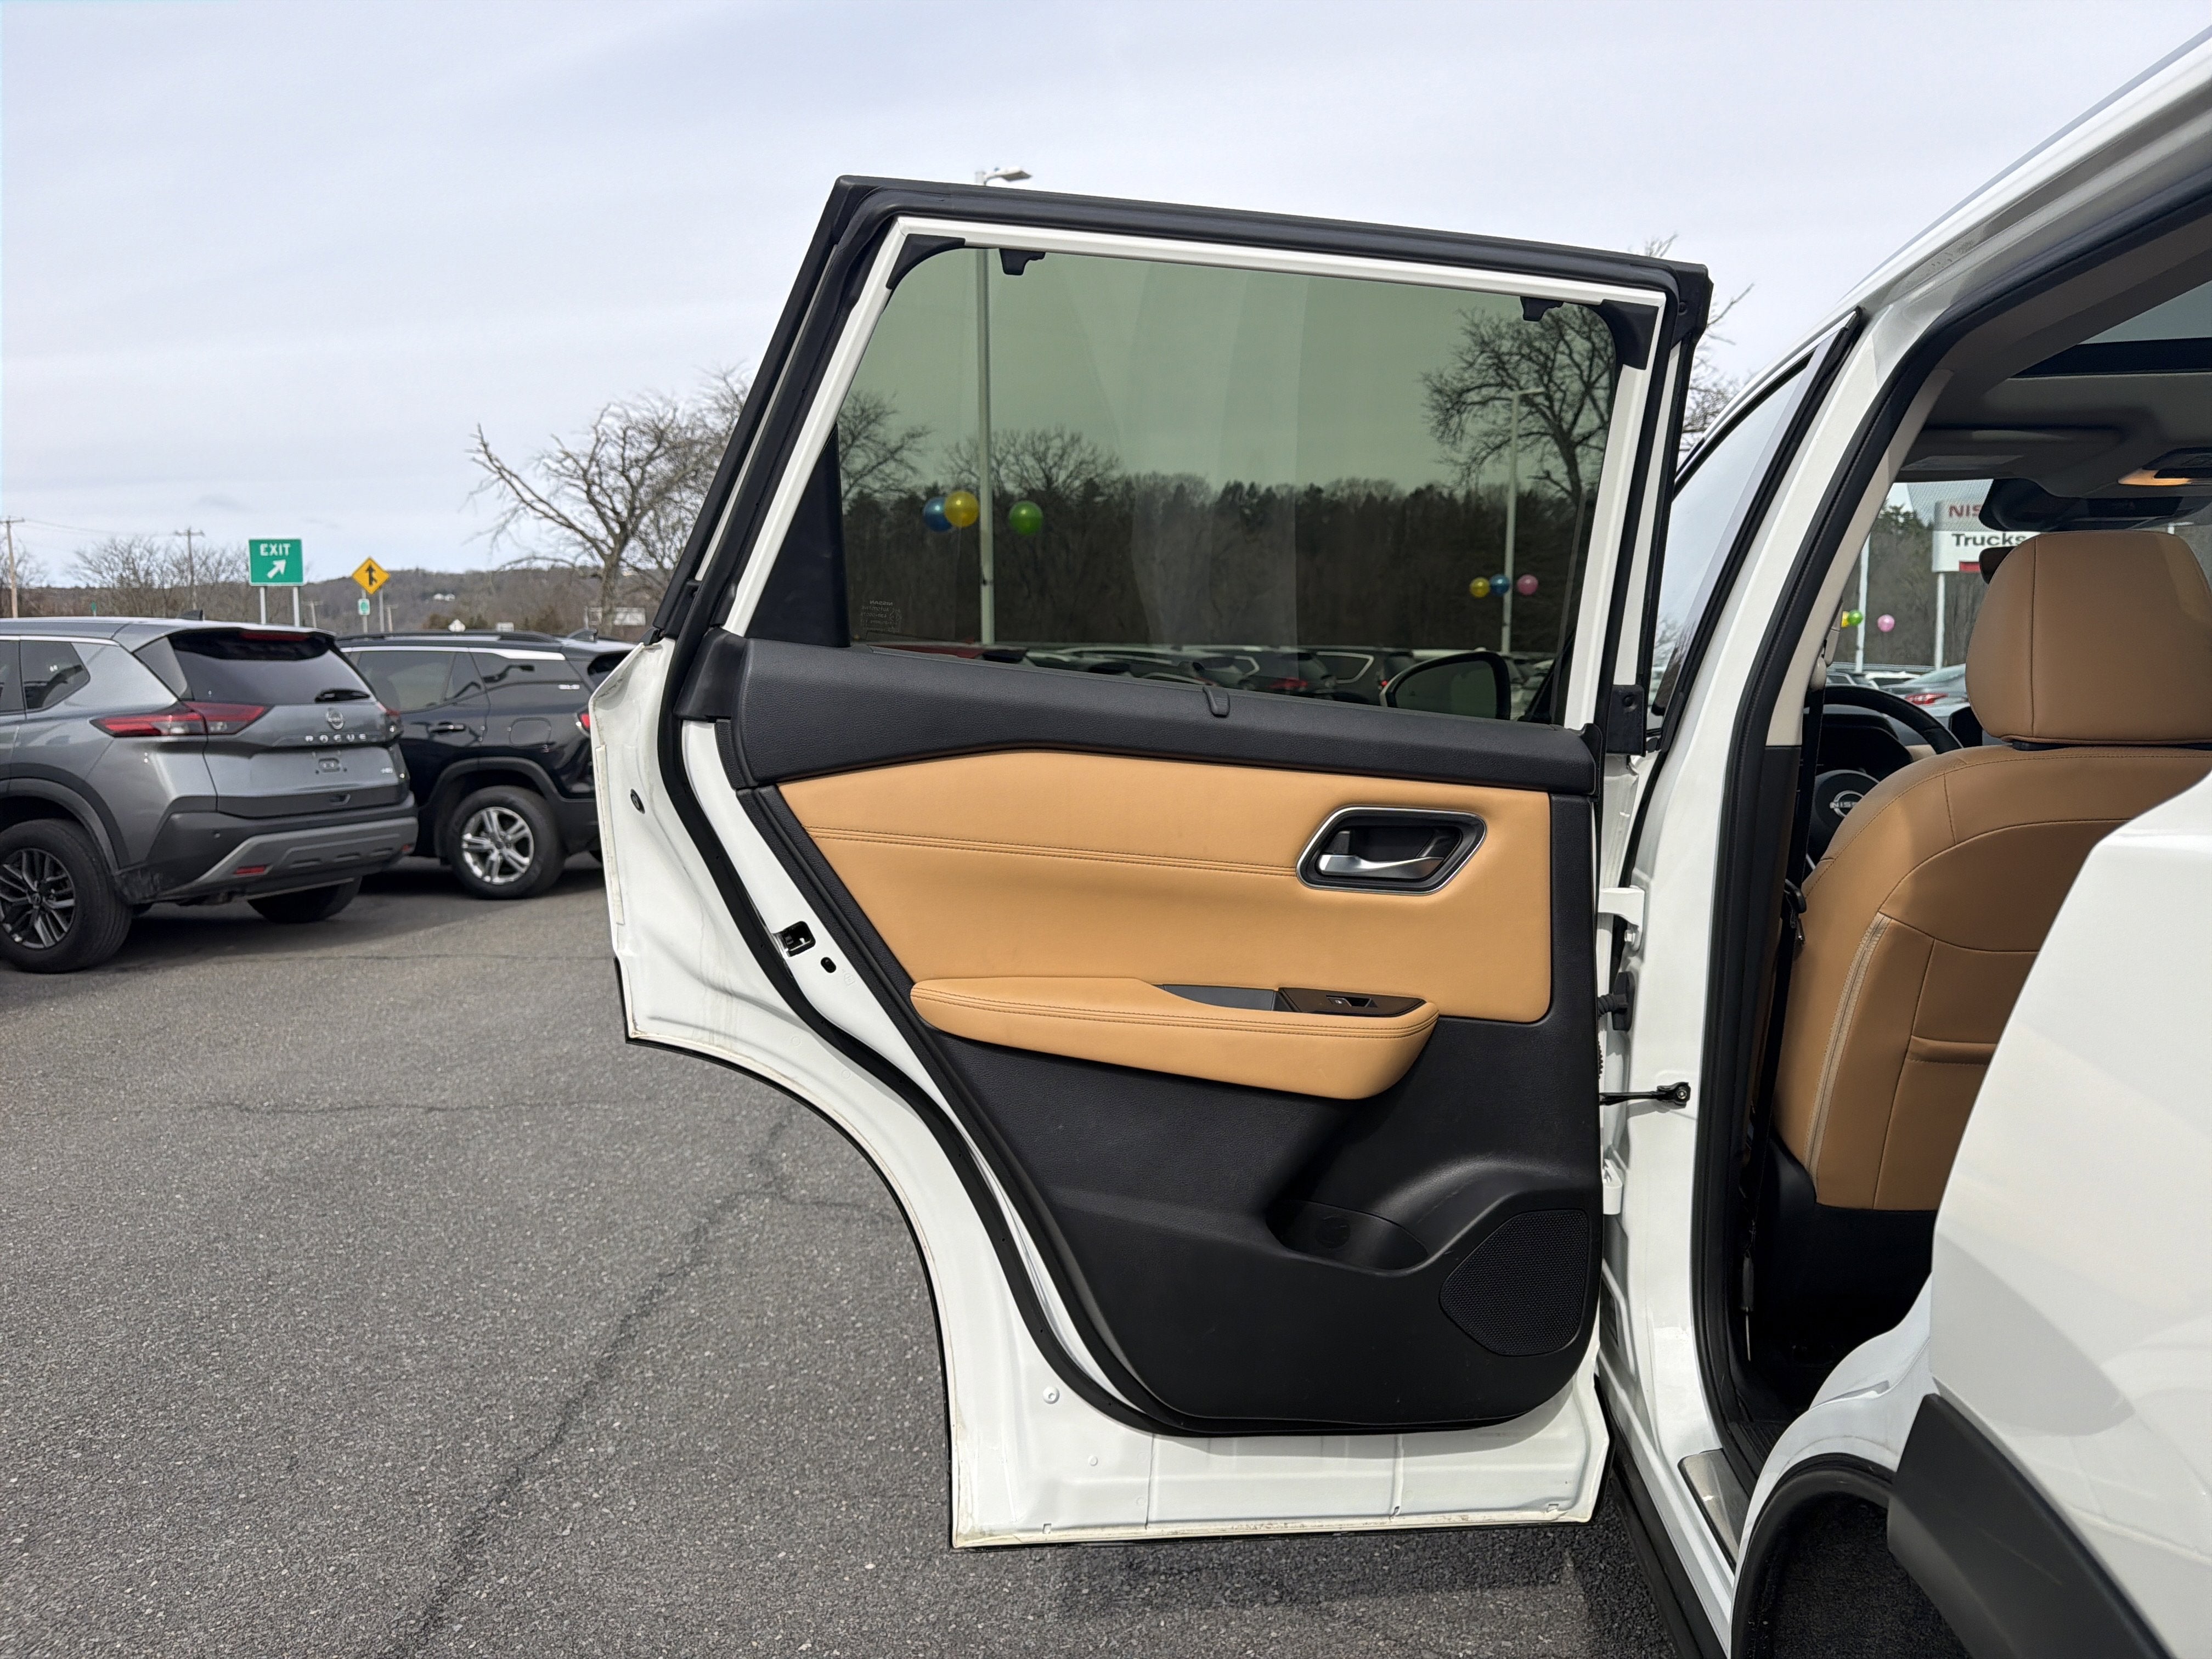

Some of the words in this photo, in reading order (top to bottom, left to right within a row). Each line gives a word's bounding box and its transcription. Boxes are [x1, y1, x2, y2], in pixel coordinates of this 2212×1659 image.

[1951, 533, 2027, 546] Trucks
[260, 543, 291, 556] EXIT
[305, 733, 366, 743] ROGUE
